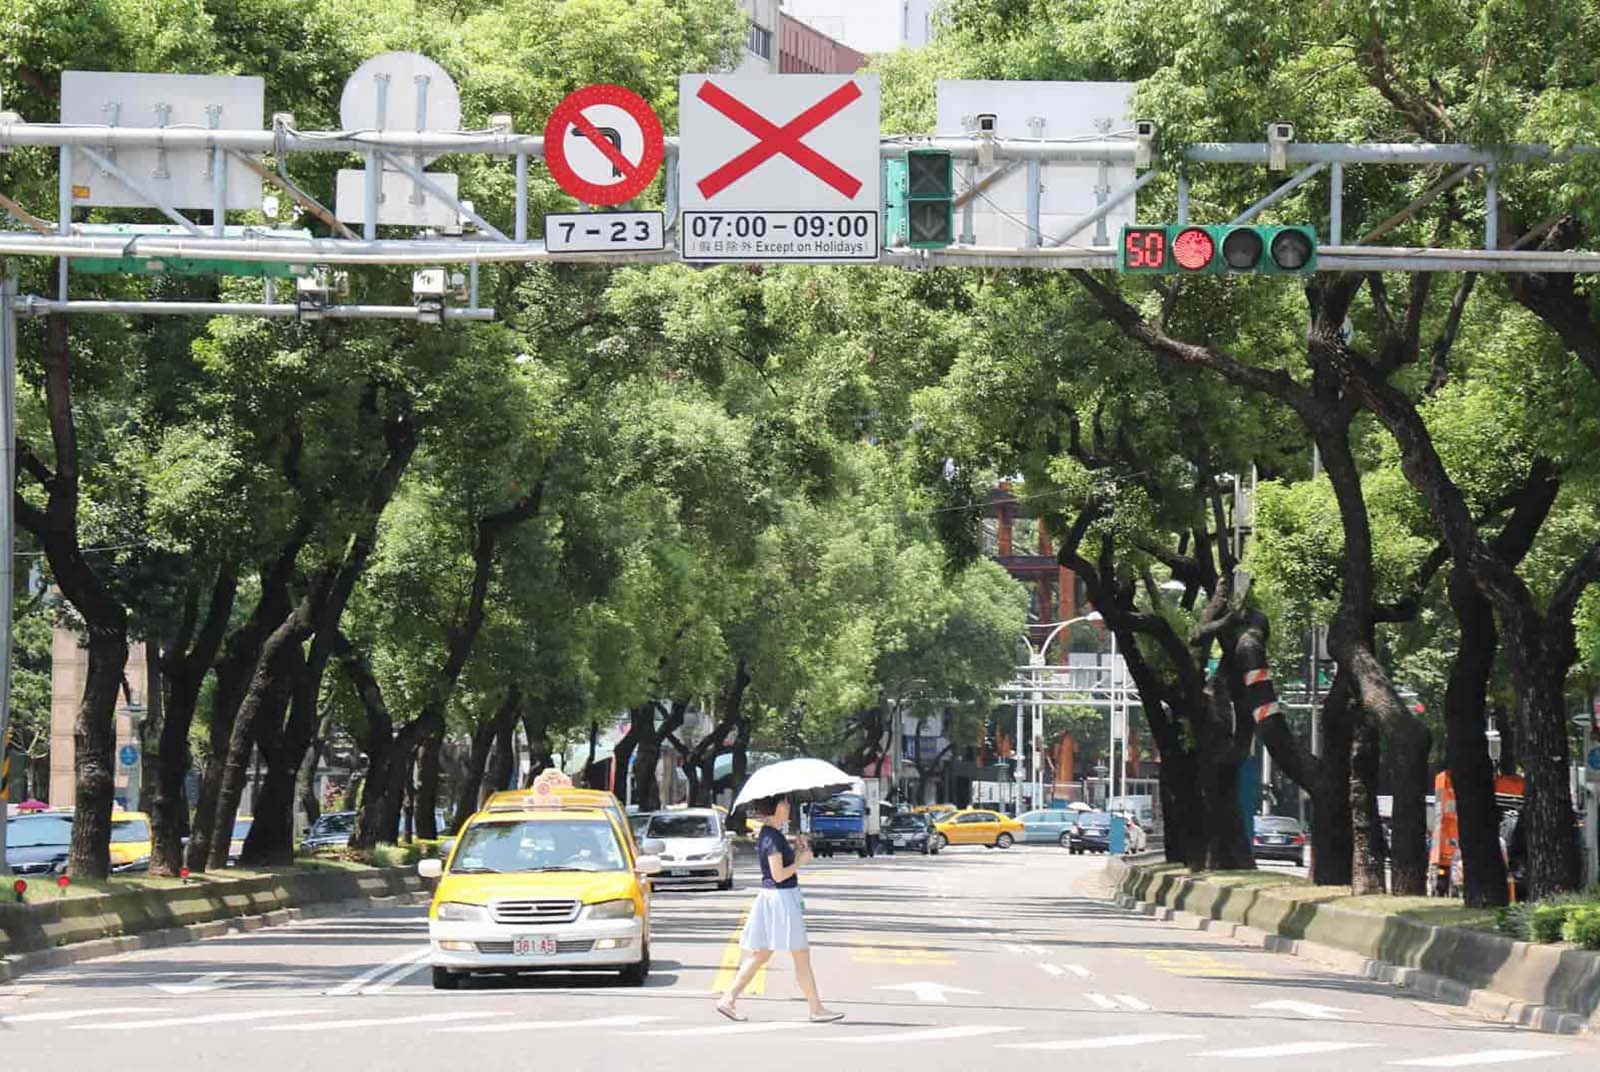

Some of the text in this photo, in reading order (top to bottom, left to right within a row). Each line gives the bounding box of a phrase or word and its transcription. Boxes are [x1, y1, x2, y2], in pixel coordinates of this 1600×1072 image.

[756, 241, 794, 254] Except
[797, 243, 811, 252] on
[1126, 231, 1163, 268] 50
